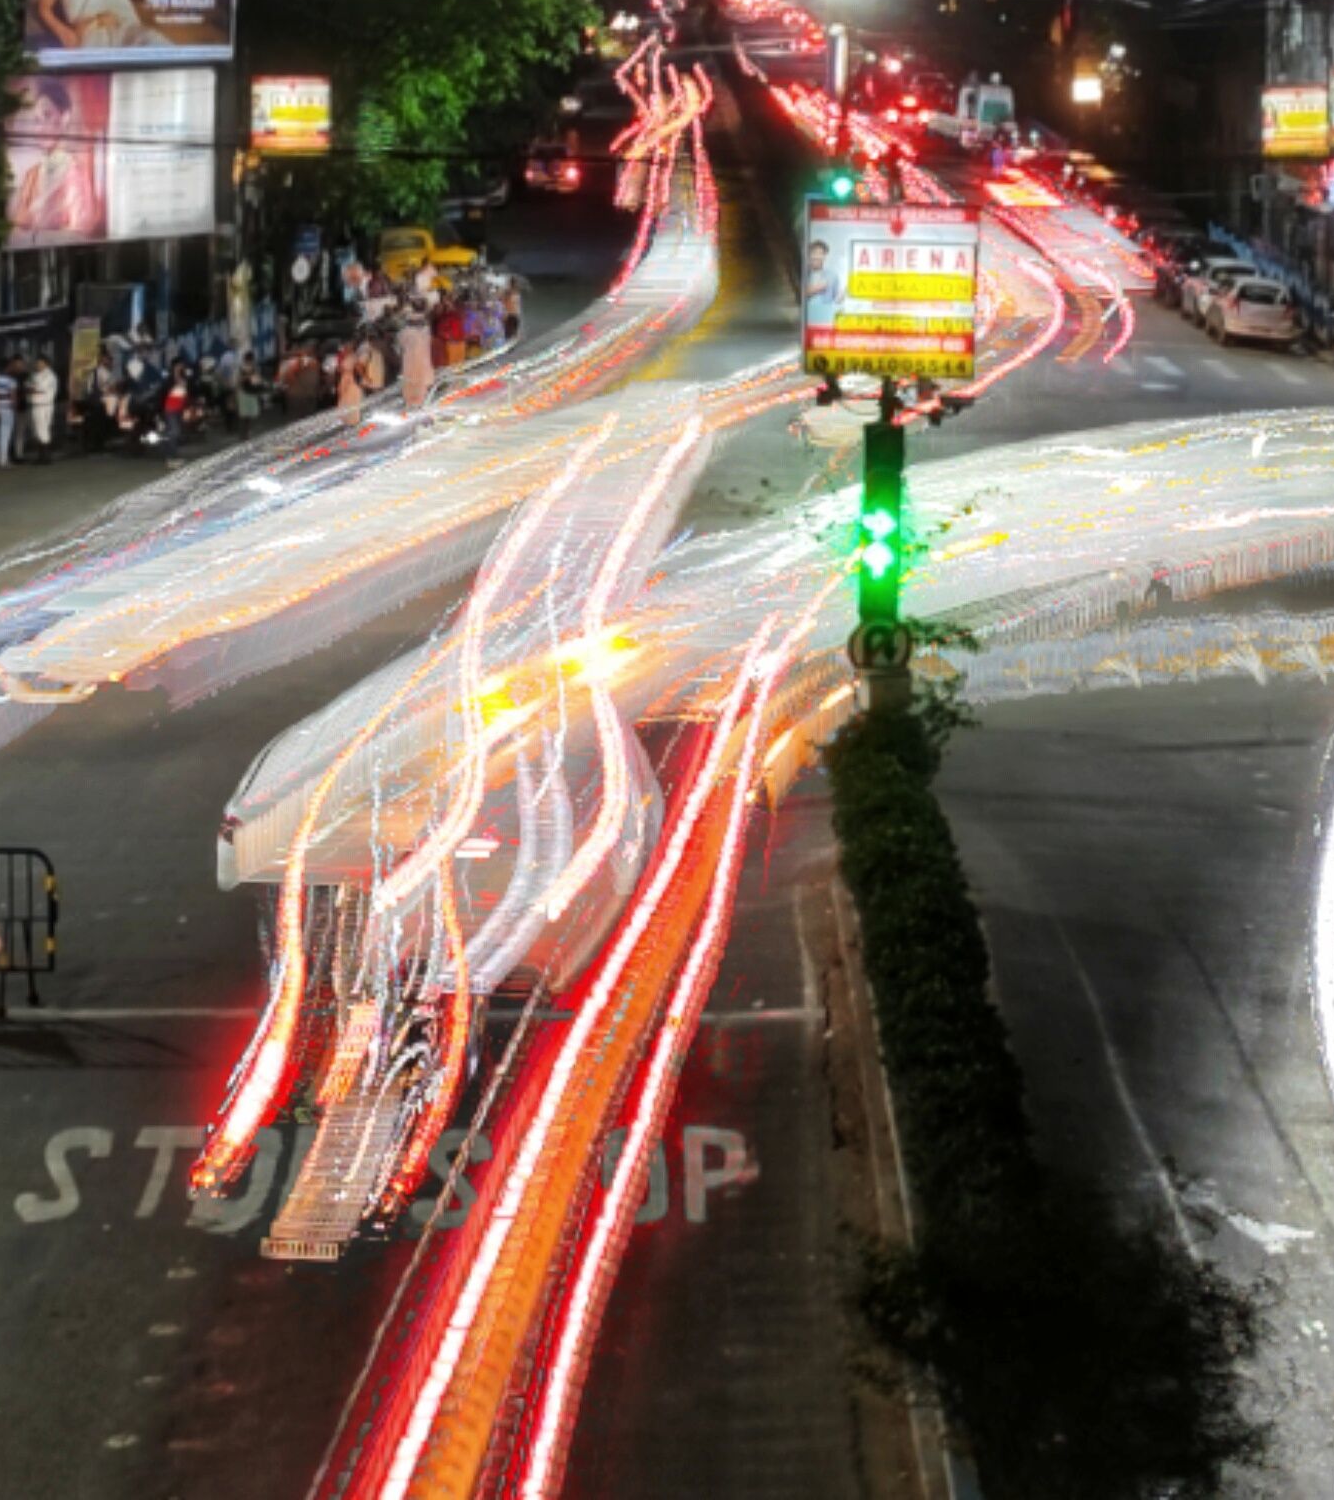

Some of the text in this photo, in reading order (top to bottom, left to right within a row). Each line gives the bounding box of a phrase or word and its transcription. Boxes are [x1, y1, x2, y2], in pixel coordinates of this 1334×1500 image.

[858, 247, 967, 269] ARENA
[855, 280, 970, 295] ANIMATION
[13, 1125, 357, 1235] STO
